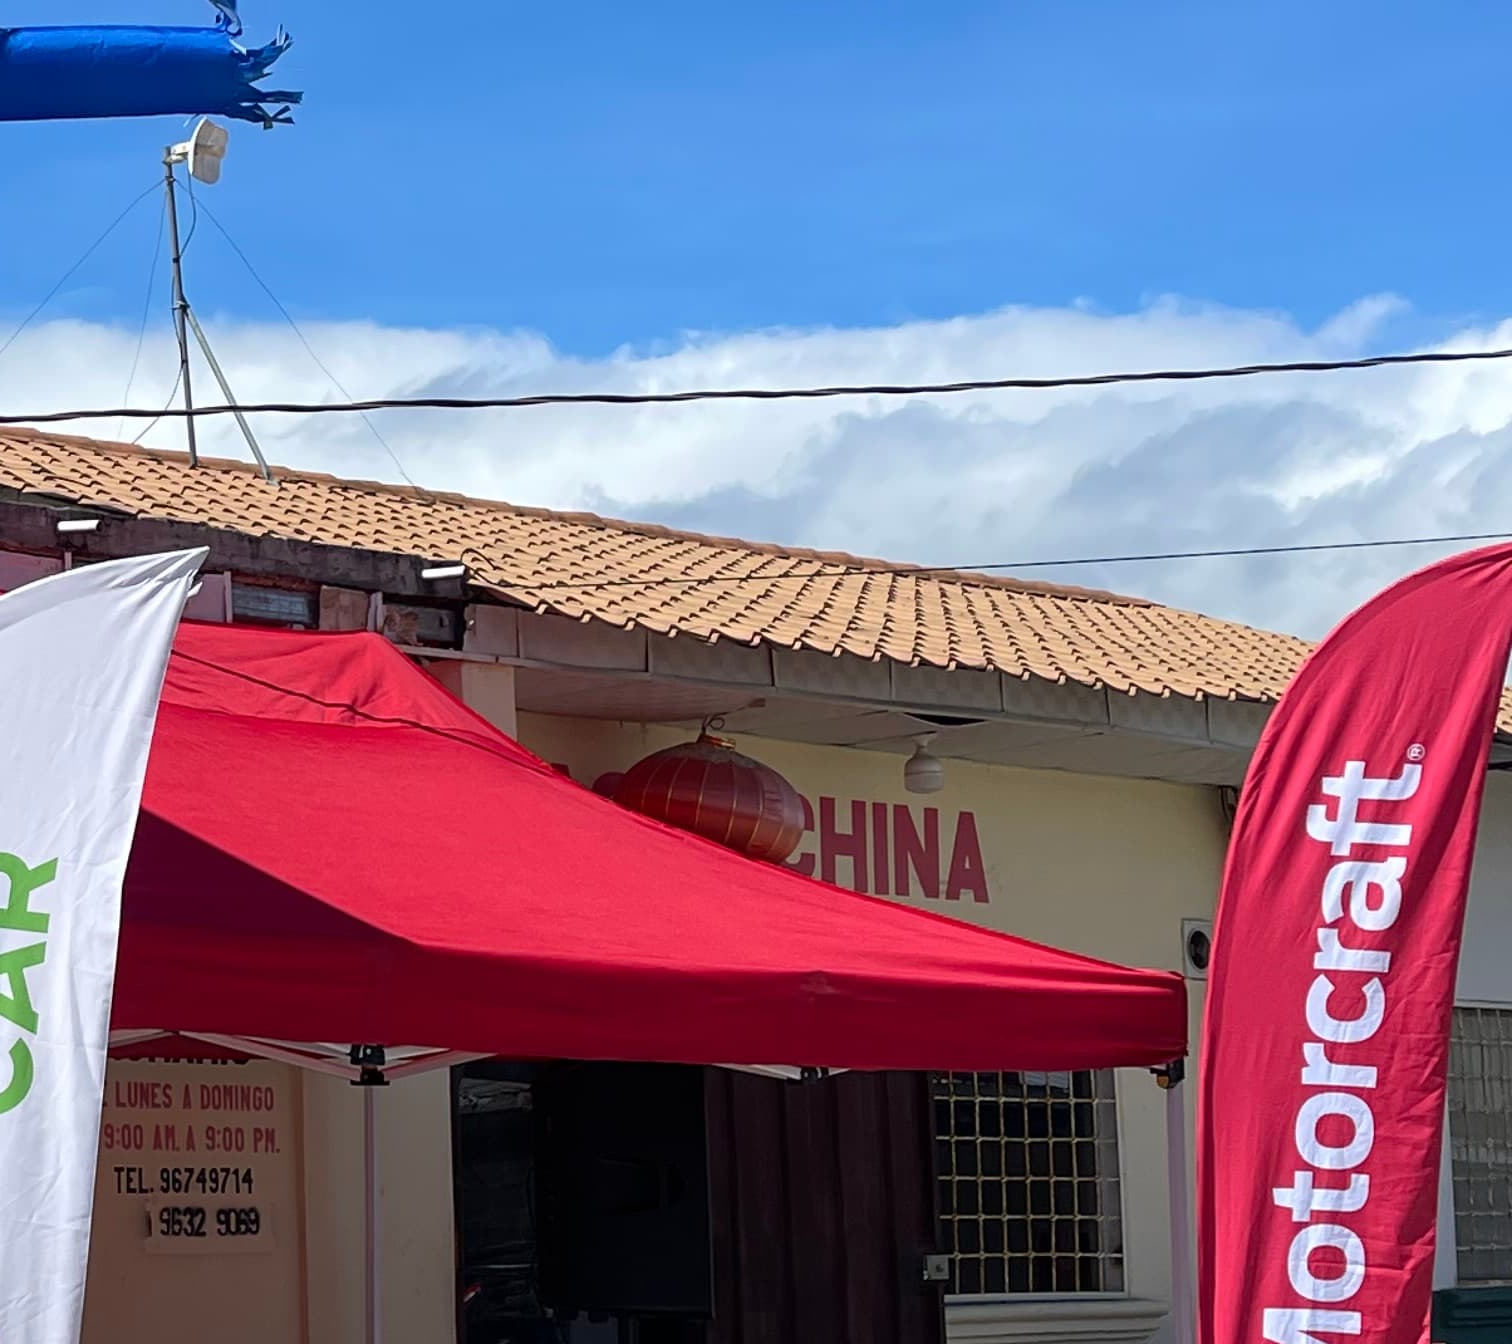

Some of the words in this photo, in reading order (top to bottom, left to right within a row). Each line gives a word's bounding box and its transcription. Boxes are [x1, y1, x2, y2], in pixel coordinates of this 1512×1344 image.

[115, 1082, 173, 1109] LUNES
[182, 1084, 193, 1110] A
[200, 1084, 275, 1112] DOMINGO
[104, 1123, 144, 1151] 9:00
[152, 1125, 180, 1153] AM.
[186, 1126, 197, 1153] A
[205, 1126, 245, 1153] 9:00
[253, 1128, 281, 1155] PM.
[113, 1166, 155, 1195] TEL.
[159, 1167, 254, 1195] 96749714
